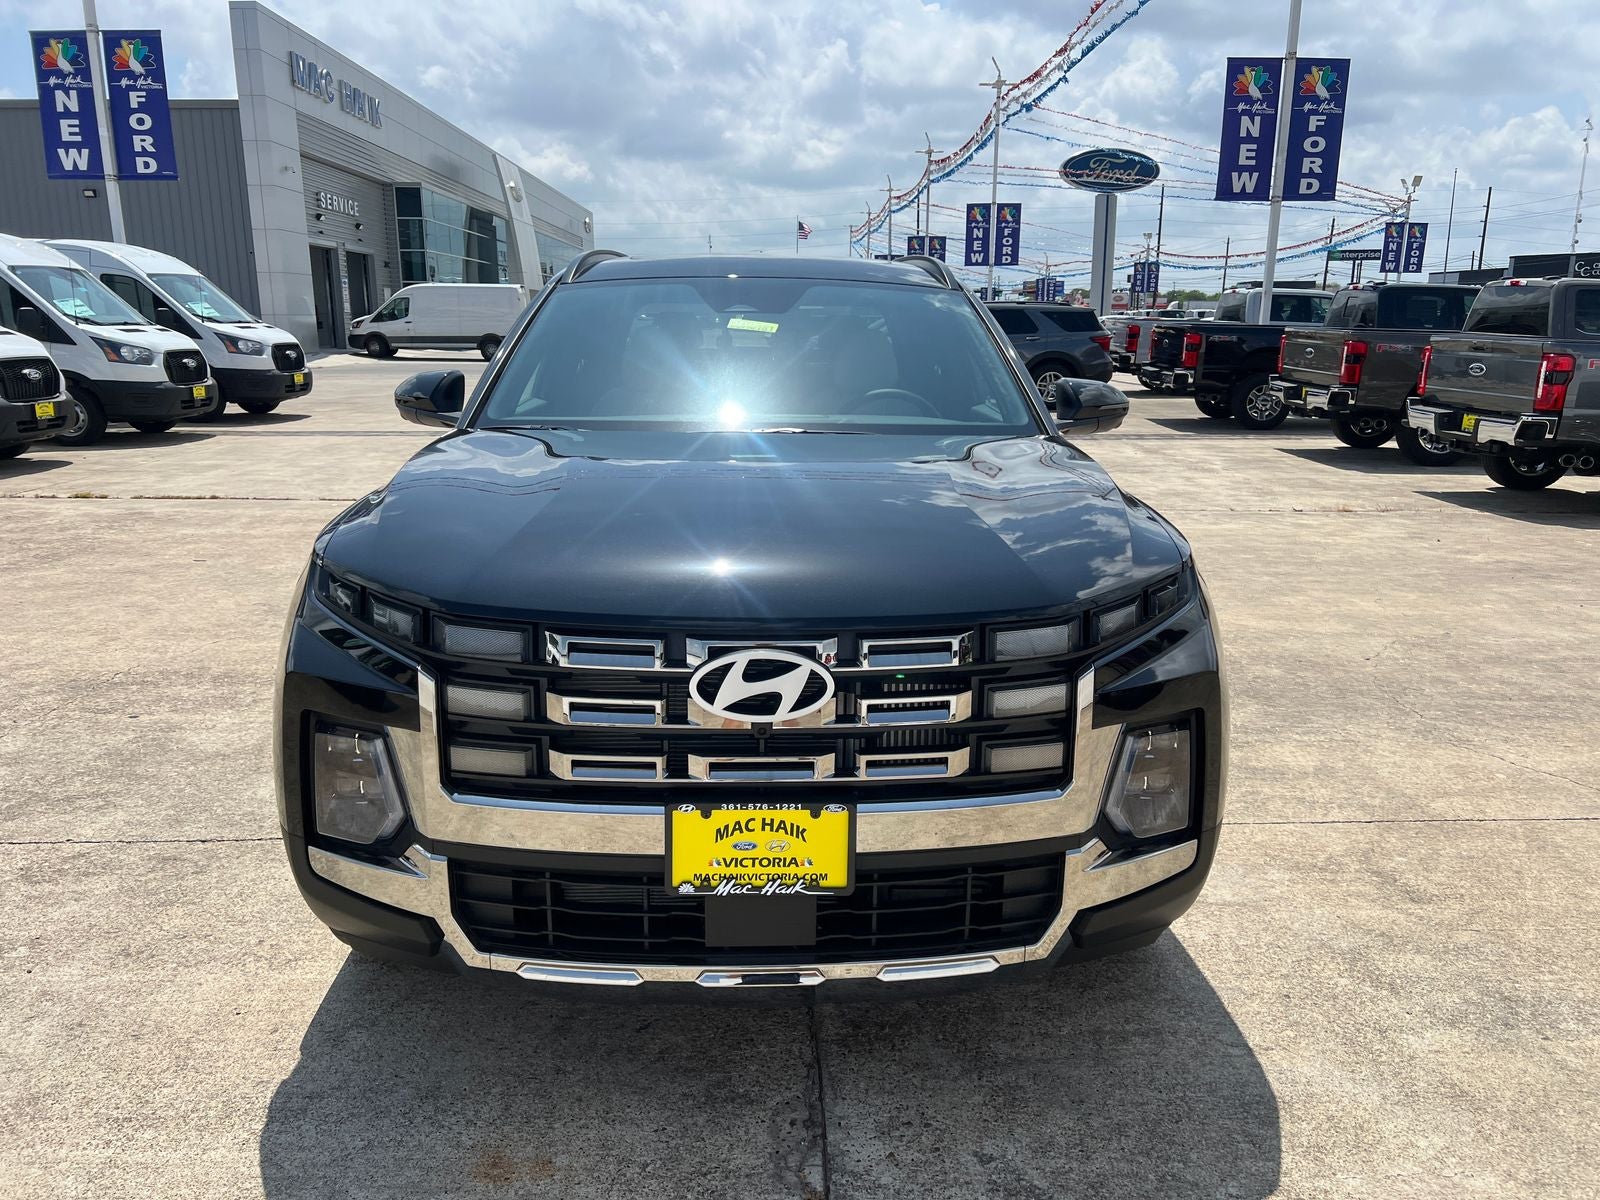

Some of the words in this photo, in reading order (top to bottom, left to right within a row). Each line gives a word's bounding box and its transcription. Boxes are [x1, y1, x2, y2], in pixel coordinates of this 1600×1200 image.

[289, 50, 336, 104] MAC
[338, 79, 383, 129] HAIK
[54, 89, 90, 171] NEW
[128, 91, 158, 174] FORD
[1085, 156, 1141, 182] Ford
[1231, 115, 1261, 194] NEW
[1298, 115, 1327, 195] FORD
[319, 191, 360, 217] SERVICE
[970, 228, 984, 263] NEW
[1001, 228, 1013, 264] FORD
[1385, 242, 1397, 271] NEW
[1408, 242, 1420, 271] FORD
[720, 803, 803, 811] 361-576-1221
[714, 817, 756, 844] MAC
[761, 817, 808, 843] HAIK
[722, 857, 800, 868] VICTORIA
[712, 879, 758, 896] Mac
[760, 878, 810, 896] Haik
